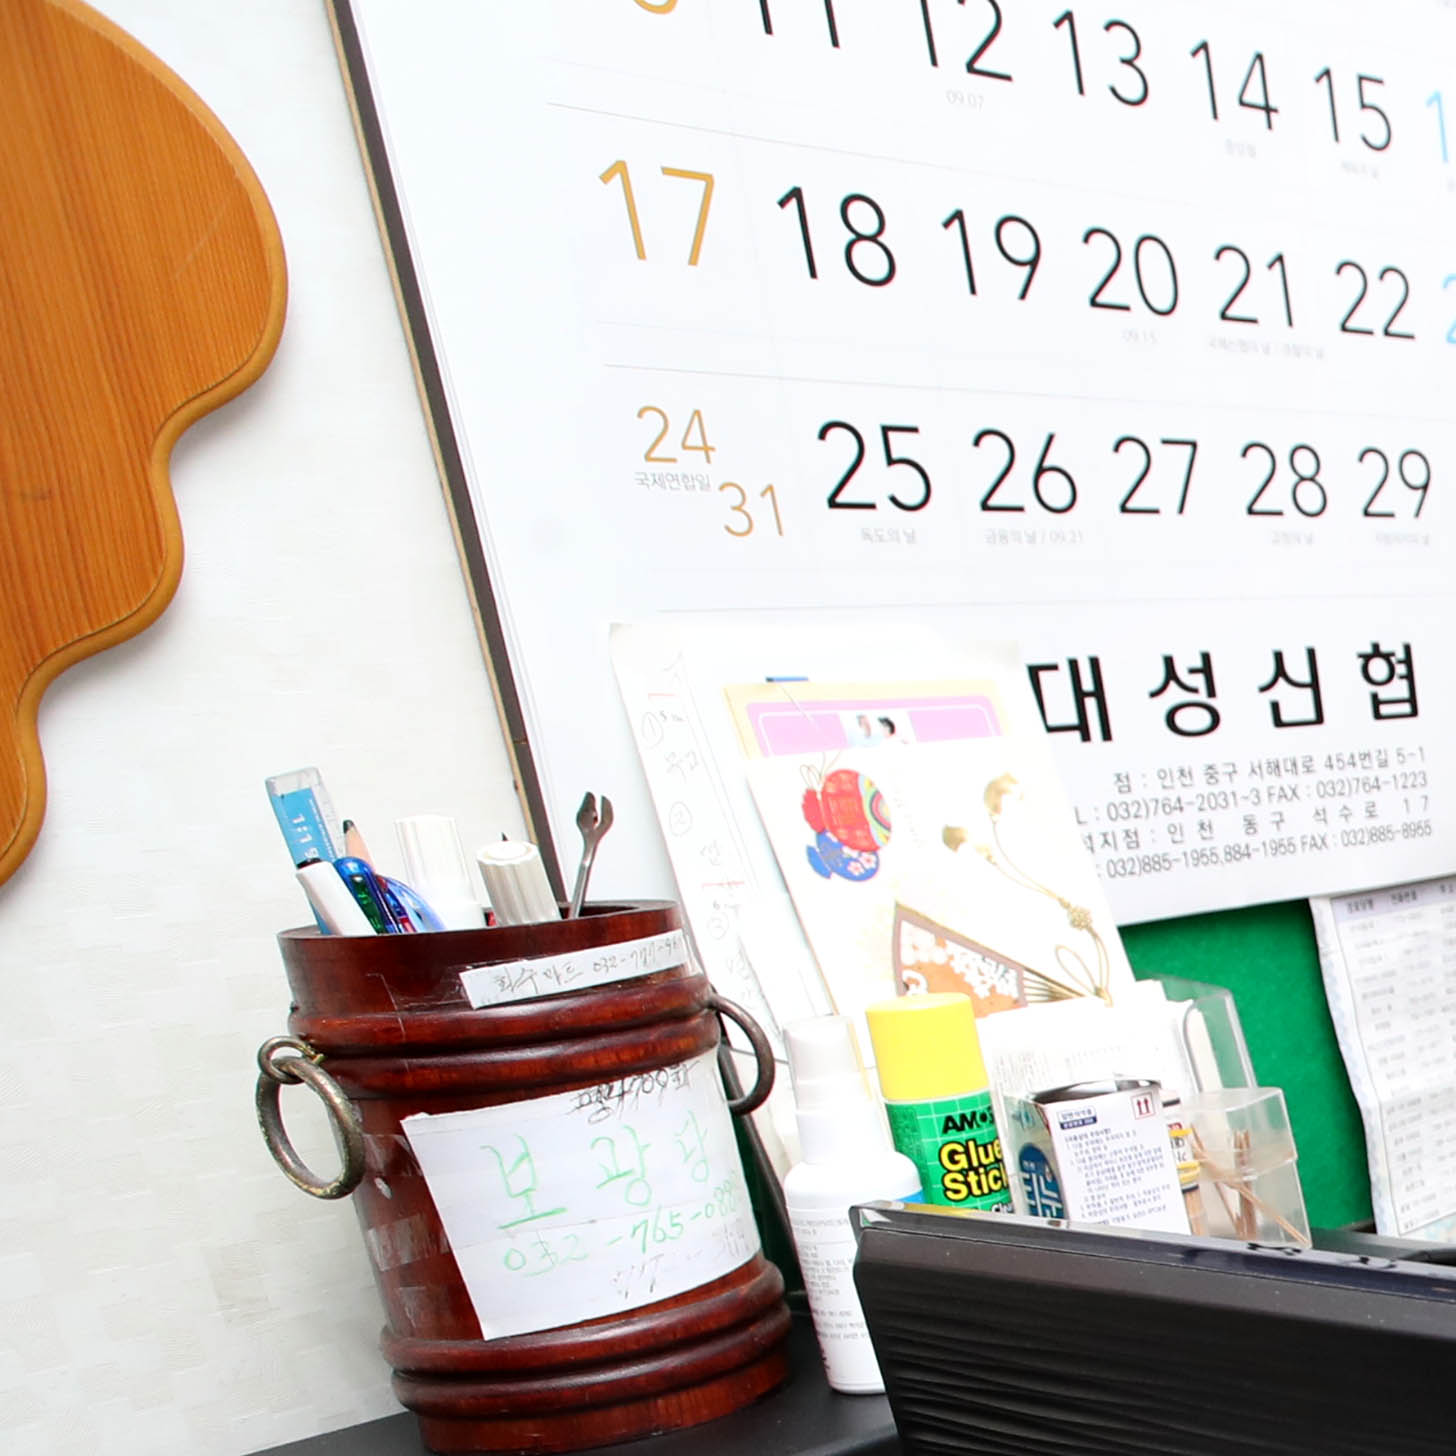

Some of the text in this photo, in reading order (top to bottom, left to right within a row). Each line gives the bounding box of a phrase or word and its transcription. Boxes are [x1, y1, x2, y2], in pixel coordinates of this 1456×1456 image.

[1053, 10, 1149, 107] 13
[1190, 40, 1278, 131] 14
[1314, 66, 1393, 152] 15
[599, 160, 716, 266] 17
[777, 186, 897, 287] 18
[942, 208, 1042, 301] 19
[1083, 226, 1179, 317] 20
[1213, 244, 1293, 328] 21
[1335, 260, 1416, 340] 22
[635, 405, 716, 465] 24
[817, 420, 933, 512] 25
[972, 428, 1078, 516] 26
[1113, 435, 1197, 515] 27
[1240, 442, 1327, 518] 28
[1358, 446, 1431, 518] 29
[718, 482, 784, 537] 31
[1026, 641, 1419, 743] 대성신협
[1157, 767, 1194, 791] 인천
[1203, 762, 1238, 786] 중구
[1248, 755, 1315, 779] 서해대로
[1324, 748, 1389, 771] 454번길
[1397, 746, 1426, 766] 5-1
[1268, 783, 1300, 803] FAX
[1300, 832, 1328, 853] FAX
